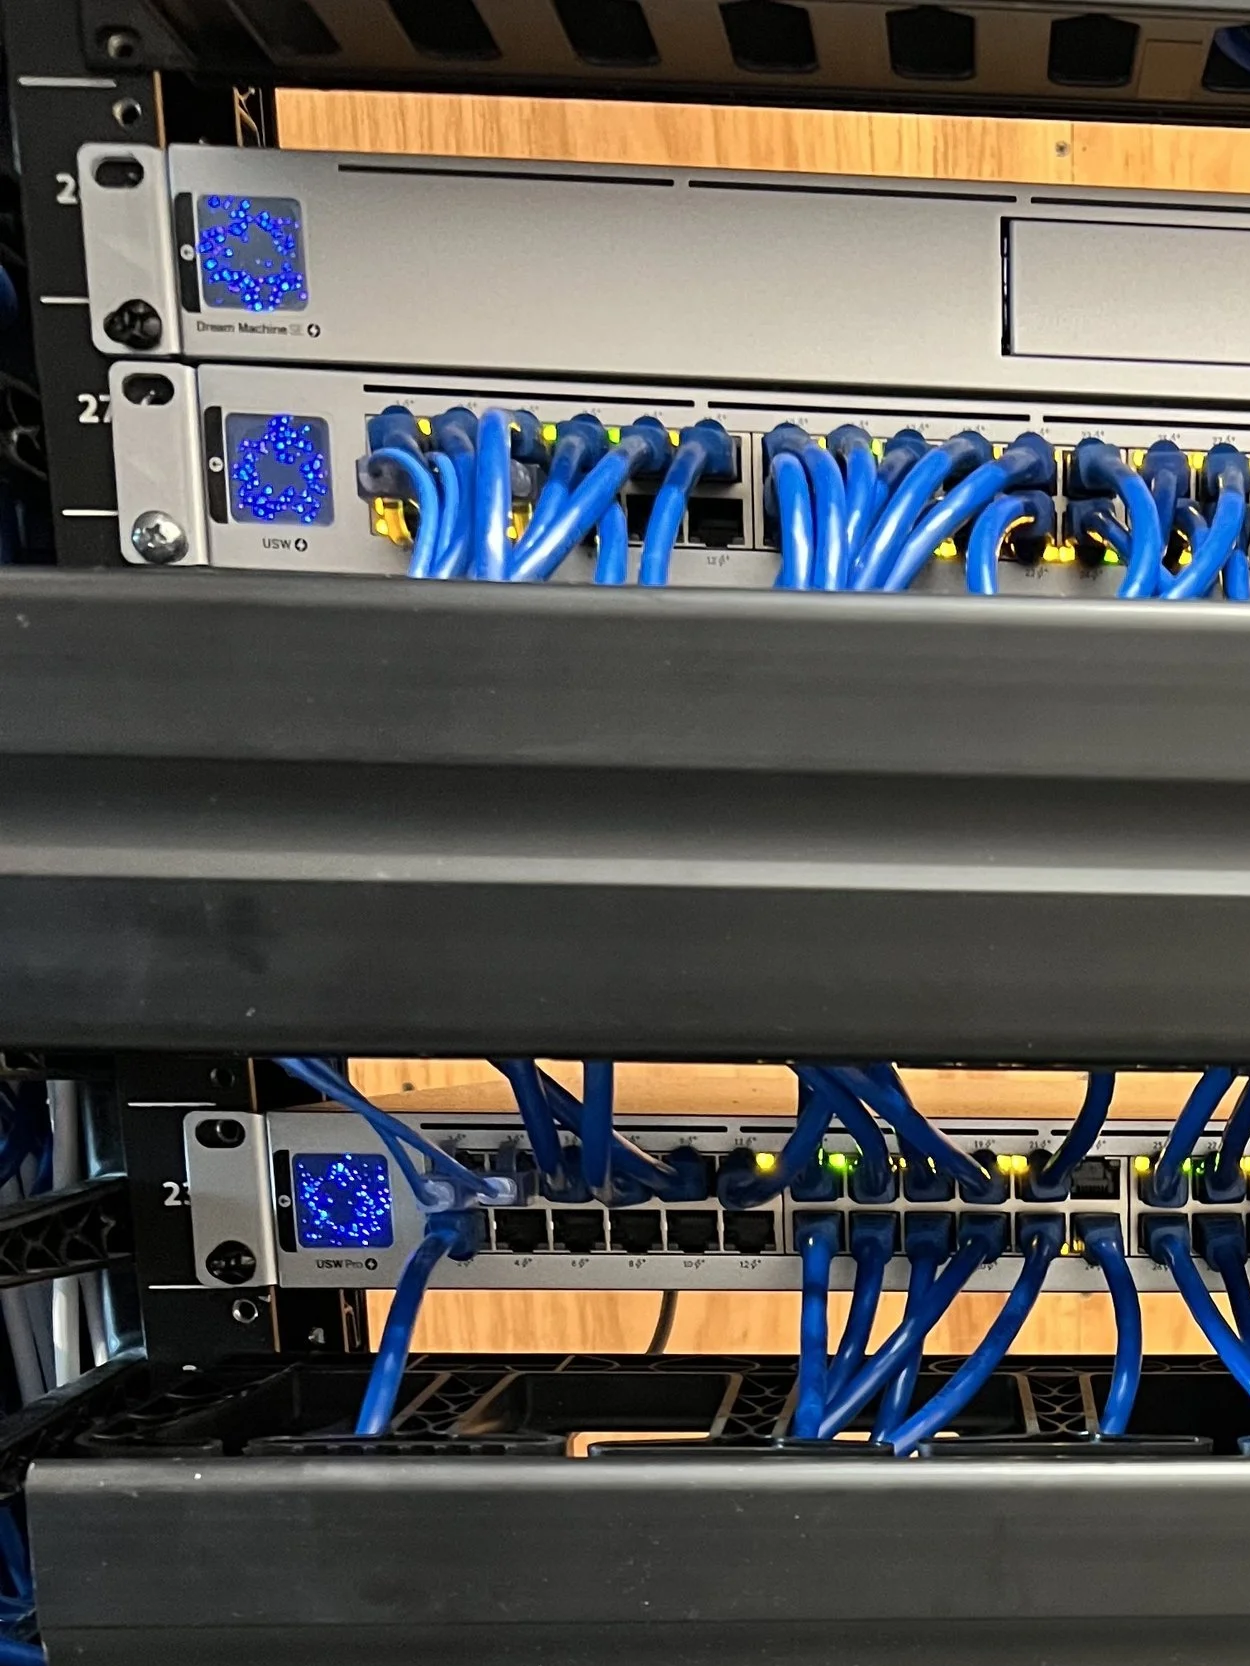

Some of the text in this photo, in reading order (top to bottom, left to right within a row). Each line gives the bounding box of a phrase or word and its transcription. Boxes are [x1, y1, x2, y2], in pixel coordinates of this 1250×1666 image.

[55, 174, 78, 204] 2
[196, 320, 235, 333] Dream
[238, 322, 288, 335] Machine
[262, 537, 292, 551] USW
[316, 1259, 343, 1270] USW
